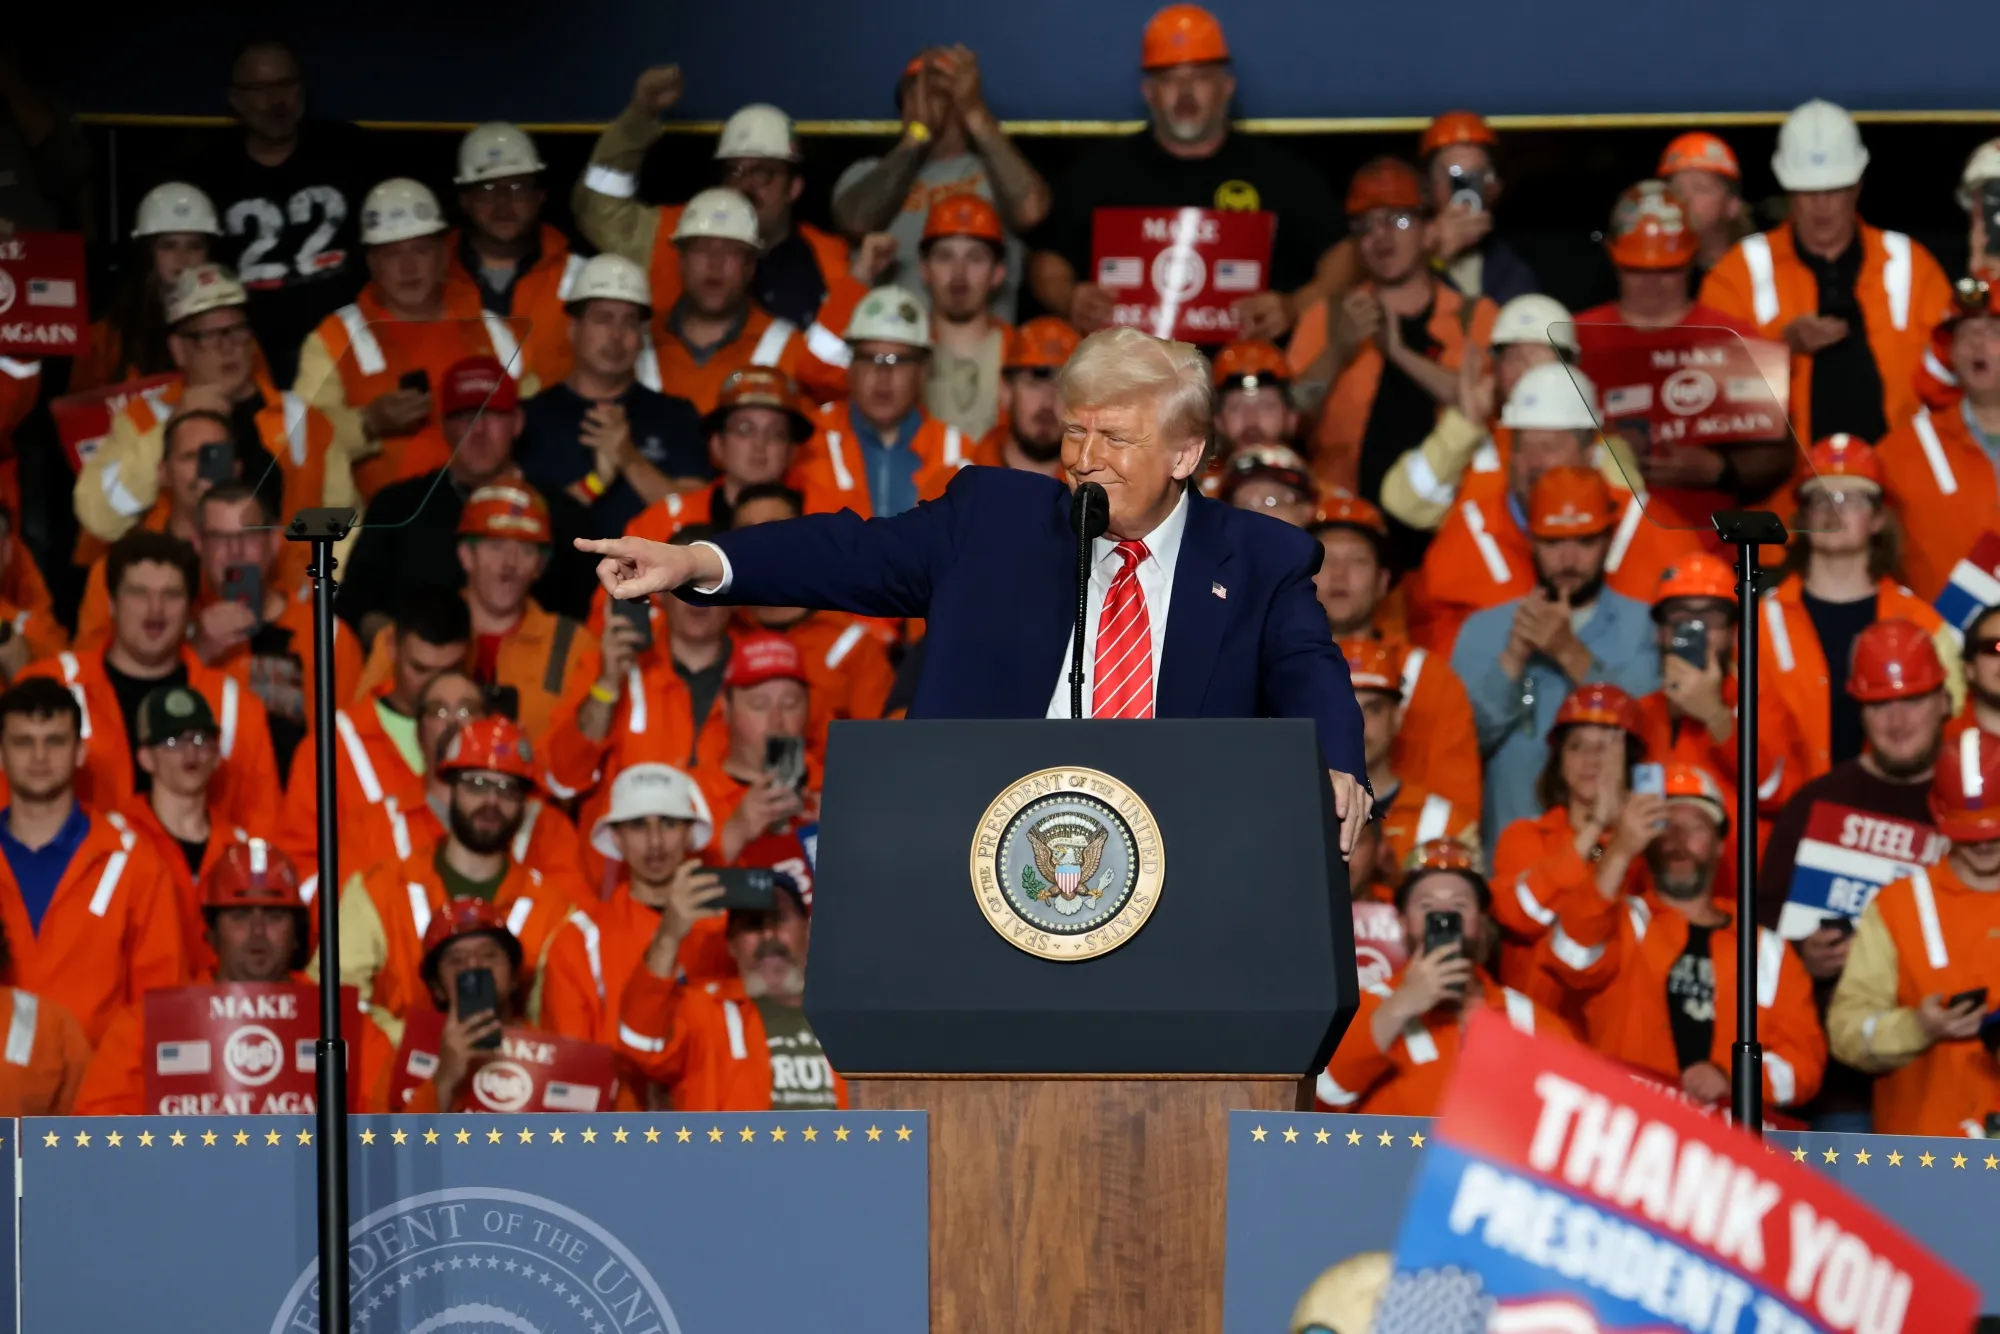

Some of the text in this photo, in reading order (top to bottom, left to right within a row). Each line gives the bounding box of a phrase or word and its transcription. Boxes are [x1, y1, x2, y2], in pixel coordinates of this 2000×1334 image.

[225, 184, 347, 283] 22
[977, 773, 1160, 951] SEAL OF THE PRESIDENT OF THE UNITED STATES
[1838, 813, 1916, 859] STEEL
[209, 993, 298, 1020] MAKE
[159, 1091, 317, 1115] GREAT AGA
[483, 1210, 524, 1234] OF
[532, 1218, 589, 1265] THE
[1527, 1070, 1914, 1334] THANK YOU
[1449, 1161, 1757, 1334] PRESIDENT
